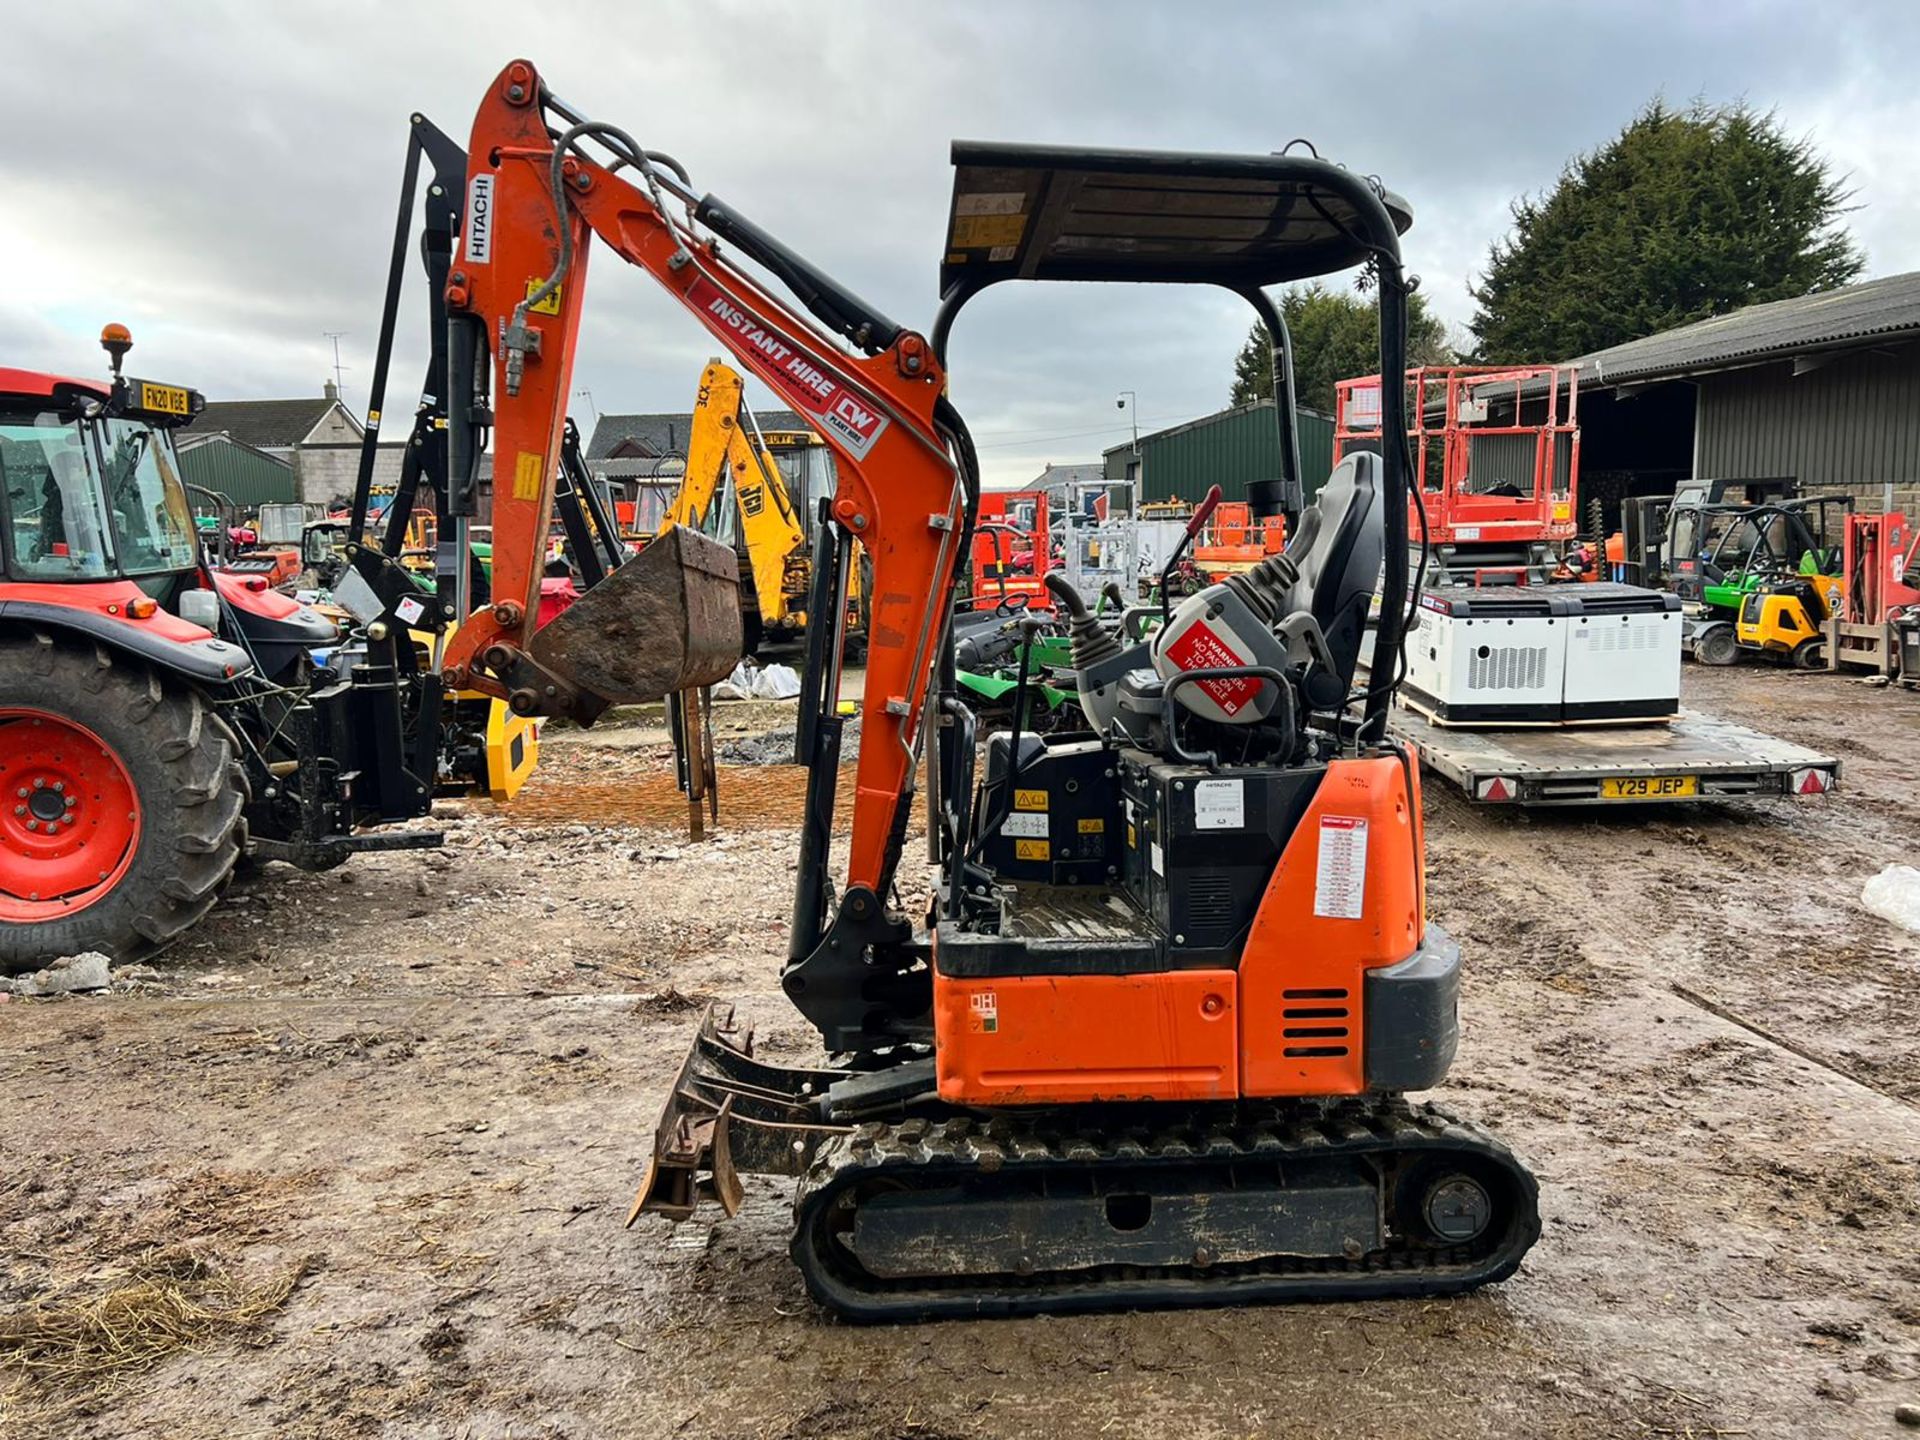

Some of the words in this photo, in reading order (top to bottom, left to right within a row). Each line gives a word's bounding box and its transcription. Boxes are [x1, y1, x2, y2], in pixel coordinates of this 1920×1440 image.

[472, 179, 488, 257] HITACHI
[708, 298, 791, 360] INSTANT
[786, 357, 836, 397] HIRE
[696, 385, 711, 408] 3CX
[829, 415, 849, 432] PLANT
[846, 429, 862, 443] HIRE
[738, 485, 763, 515] JCB
[1192, 638, 1207, 653] NO
[1192, 650, 1205, 664] TO
[1615, 780, 1649, 795] Y29
[1652, 779, 1684, 794] JEP
